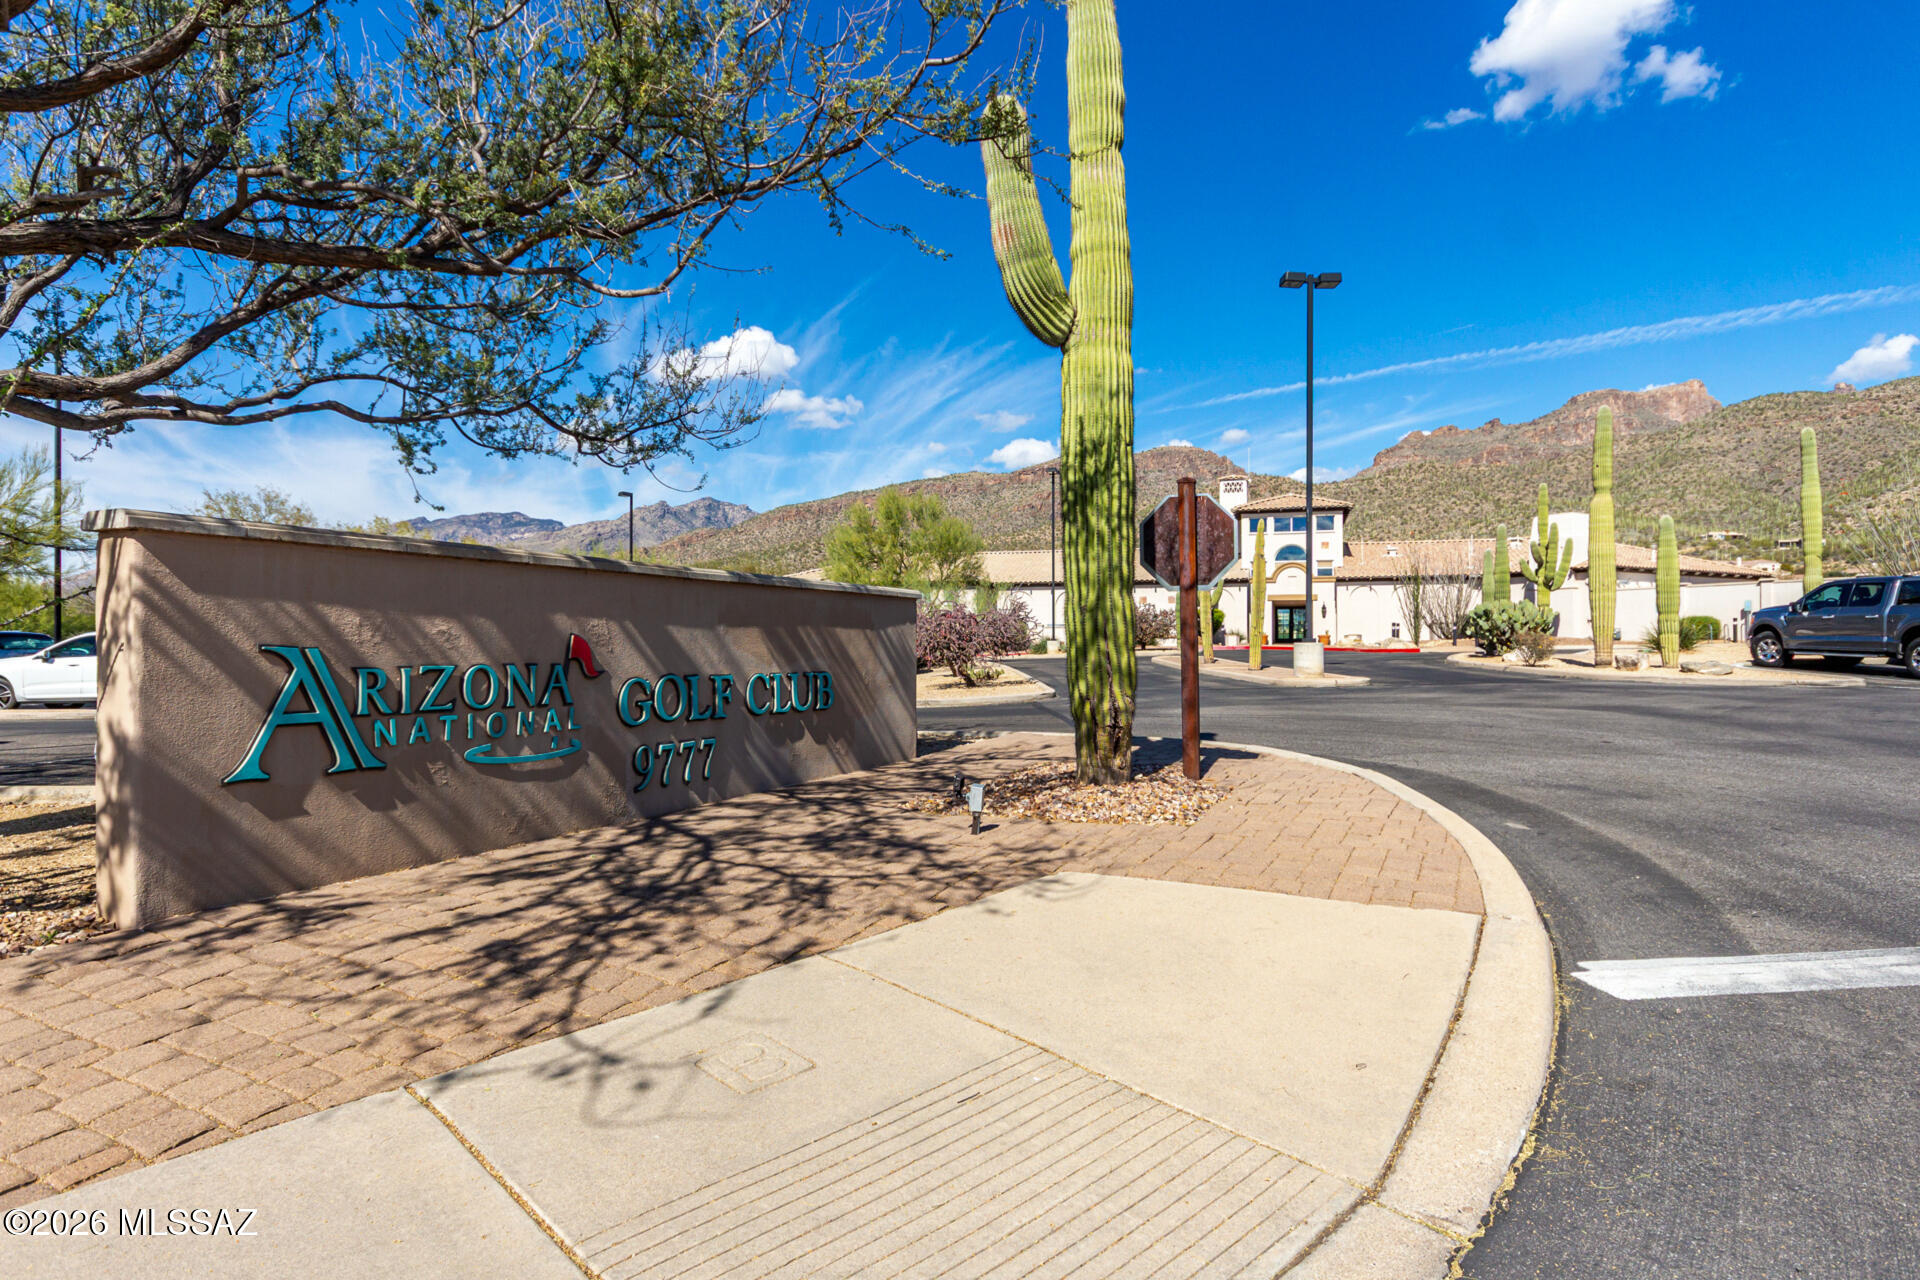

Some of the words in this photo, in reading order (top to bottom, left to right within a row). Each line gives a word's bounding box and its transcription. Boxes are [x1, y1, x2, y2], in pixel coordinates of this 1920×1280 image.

[221, 644, 576, 785] ARIZONA
[373, 706, 582, 748] NATIONAL
[616, 672, 734, 727] GOLF
[745, 671, 835, 715] CLUB
[632, 737, 717, 793] 9777
